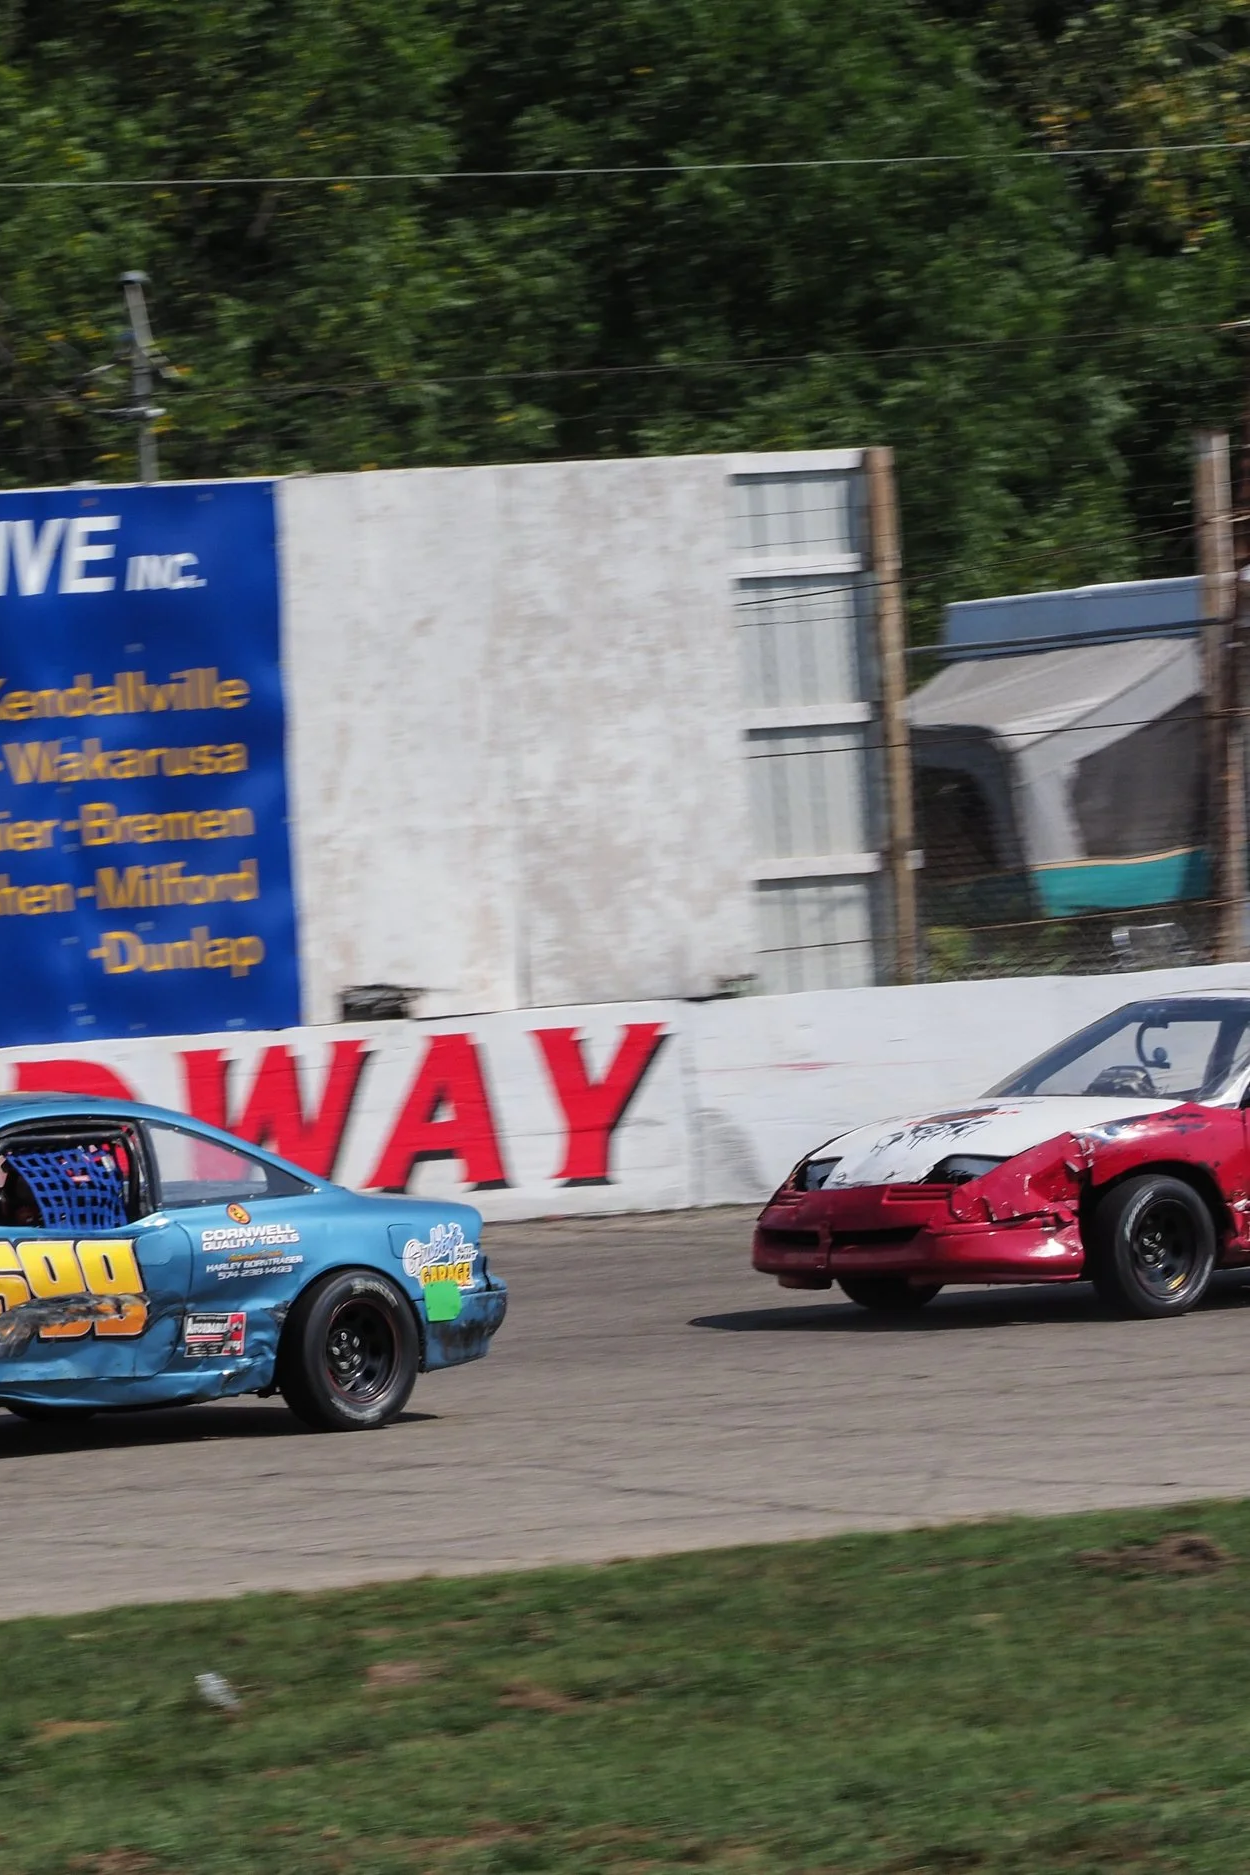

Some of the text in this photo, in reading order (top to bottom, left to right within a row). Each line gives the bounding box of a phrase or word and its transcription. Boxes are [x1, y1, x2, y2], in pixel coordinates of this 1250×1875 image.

[126, 553, 206, 591] INC.
[202, 1224, 297, 1241] CORNWELL
[203, 1233, 300, 1251] QUALITY TOOLS
